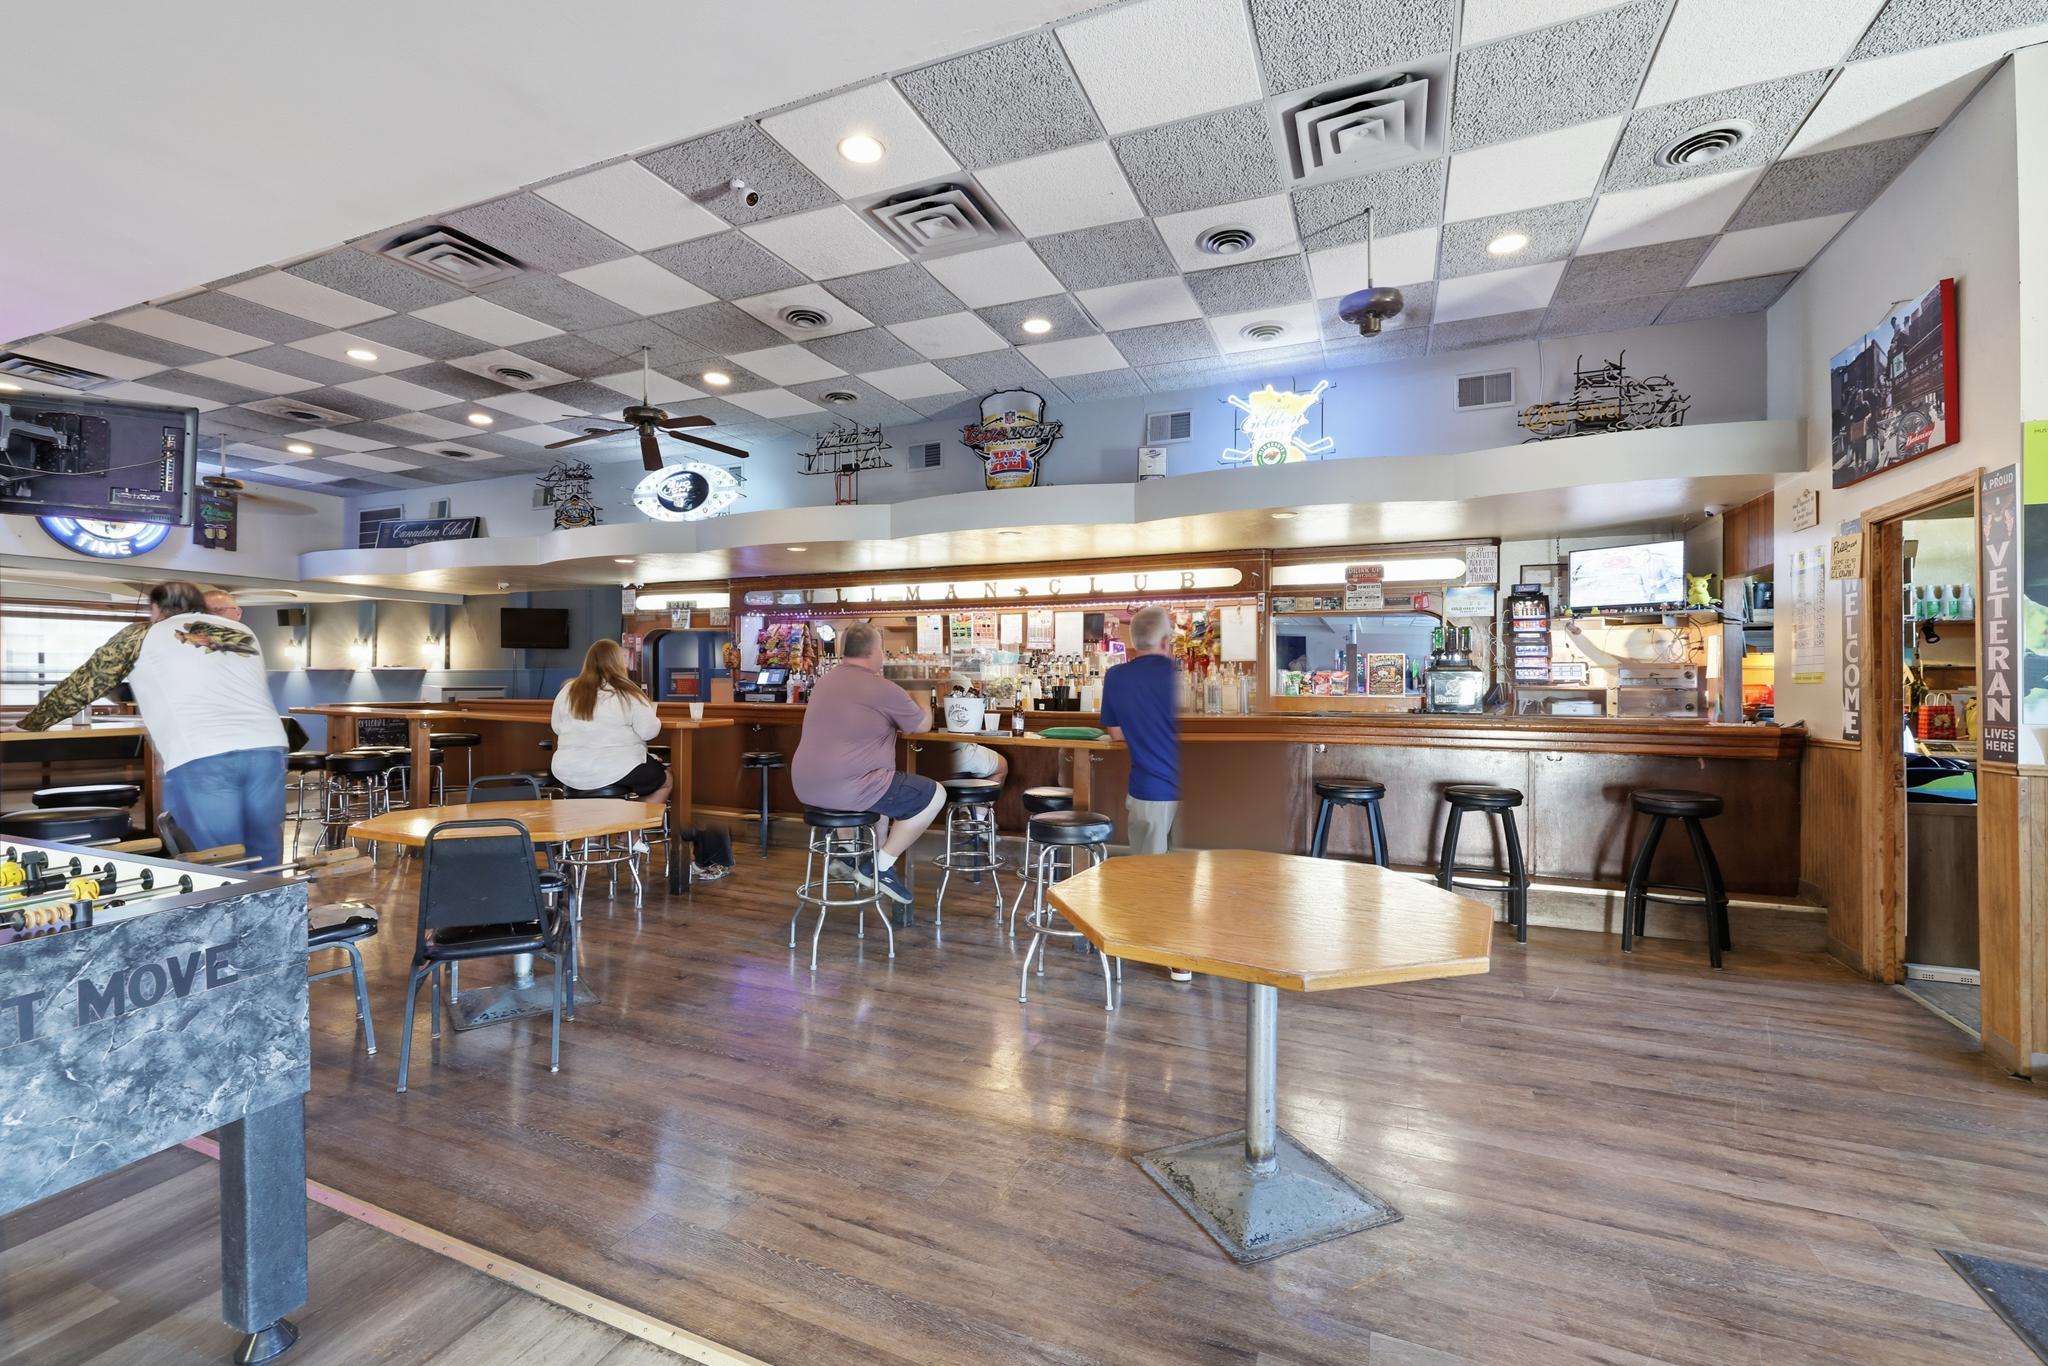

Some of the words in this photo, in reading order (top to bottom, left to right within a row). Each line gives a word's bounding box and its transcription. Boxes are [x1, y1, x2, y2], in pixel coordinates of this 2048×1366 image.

[1982, 480, 1987, 491] A
[1989, 472, 2014, 489] PROUD
[392, 523, 440, 539] Canadian
[442, 521, 470, 537] Club
[74, 533, 132, 556] TIME
[772, 582, 998, 605] PULLMAN
[1048, 571, 1196, 596] CLUB
[1986, 541, 2012, 722] VETERAN
[1984, 727, 2016, 740] LIVES
[1985, 738, 2015, 753] HERE
[77, 942, 239, 1027] MOVE
